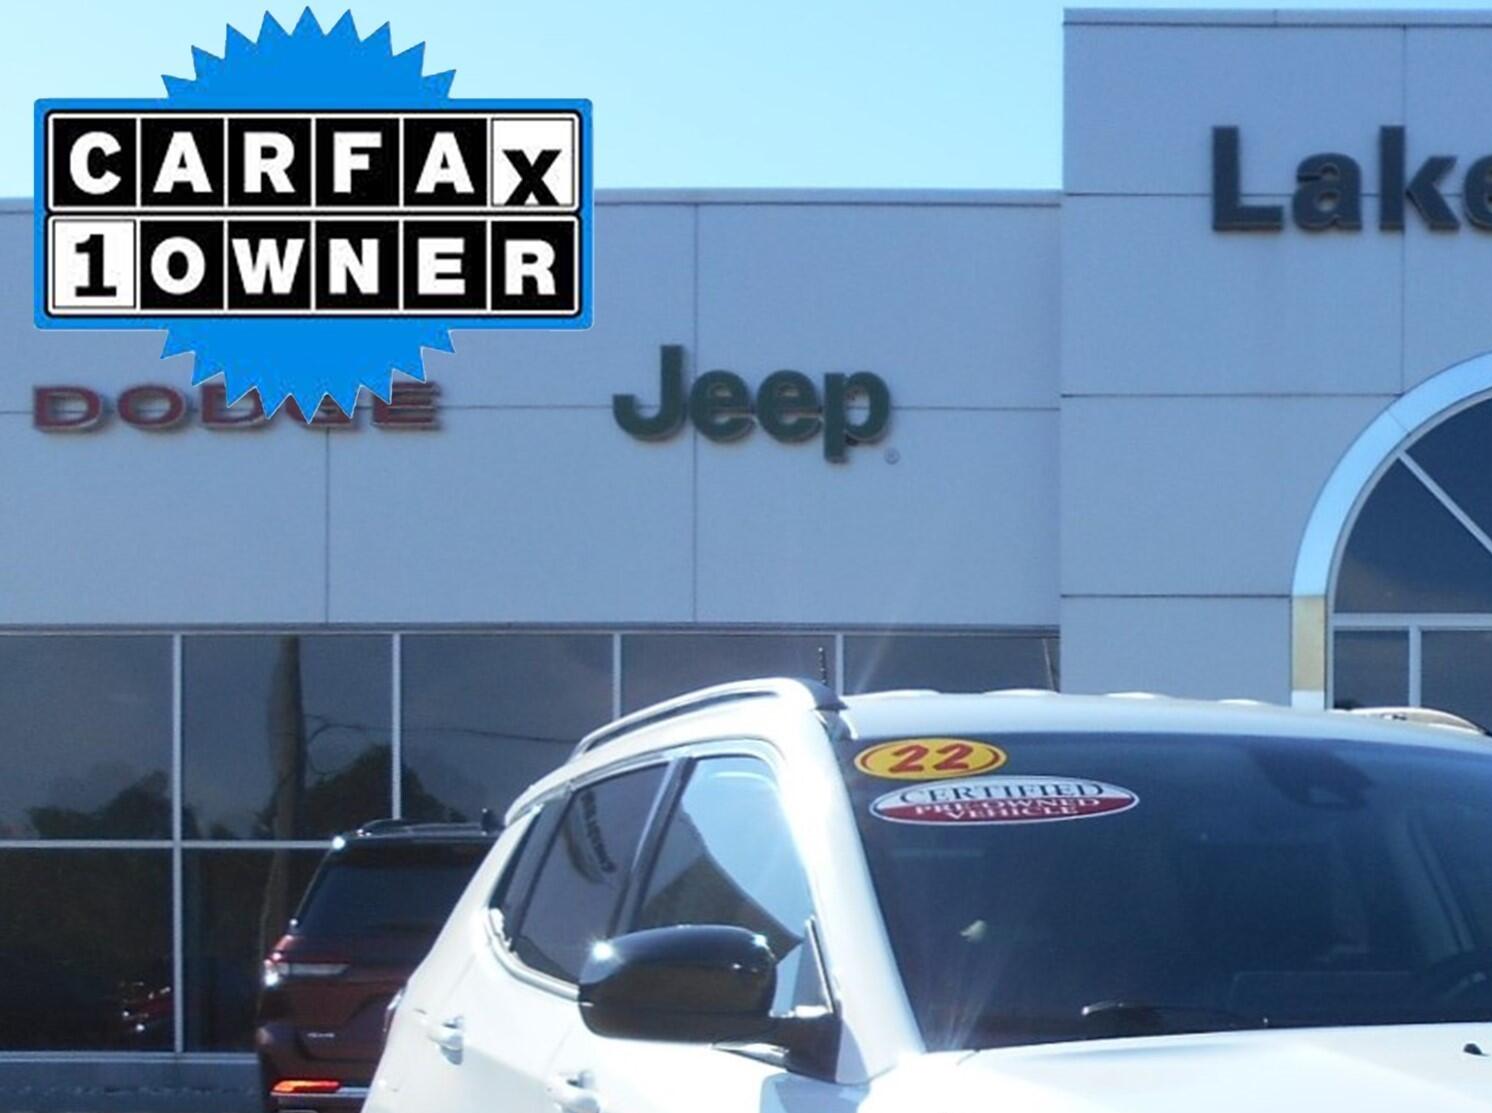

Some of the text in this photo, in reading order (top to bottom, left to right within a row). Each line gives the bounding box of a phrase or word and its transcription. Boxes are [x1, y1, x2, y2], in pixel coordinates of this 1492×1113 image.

[612, 344, 891, 464] Jeep
[888, 742, 975, 774] 22
[900, 783, 1104, 804] CERTIFIED
[945, 805, 1079, 820] VEHICLE
